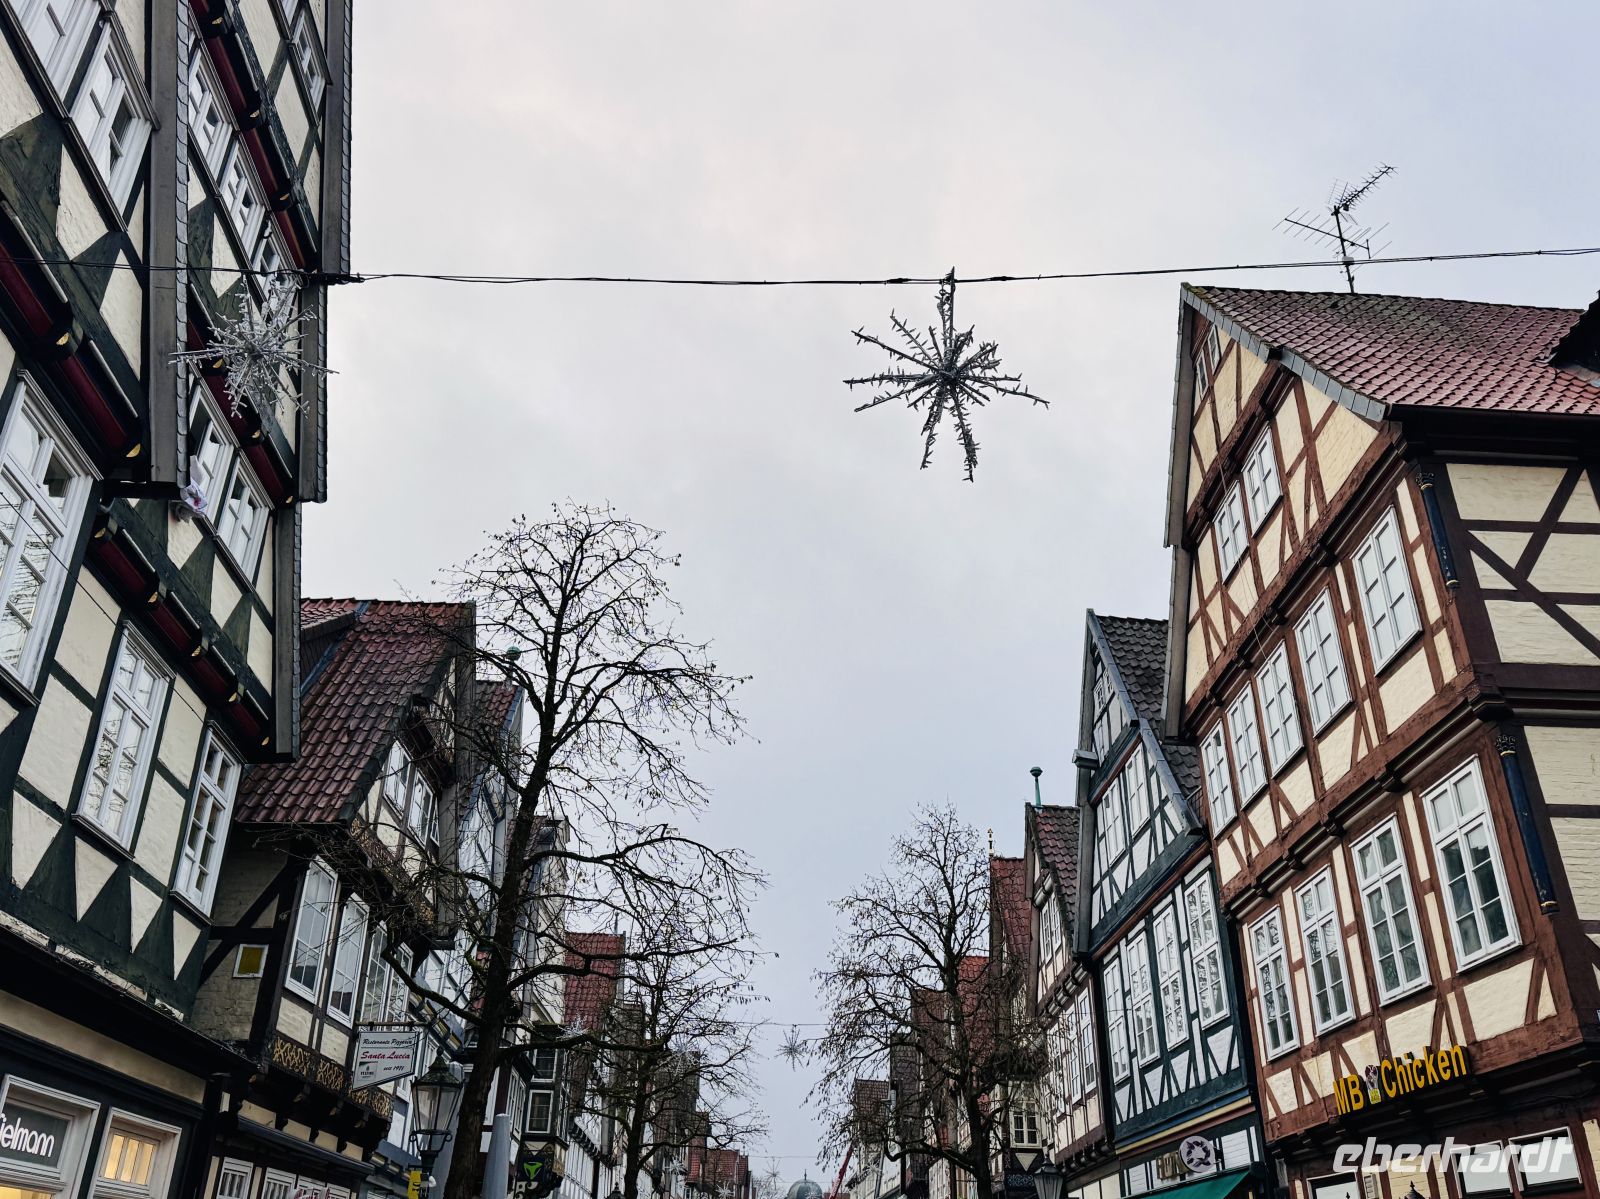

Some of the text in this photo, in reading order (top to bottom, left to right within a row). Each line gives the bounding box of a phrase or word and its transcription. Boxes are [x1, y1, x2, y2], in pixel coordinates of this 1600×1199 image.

[361, 1051, 410, 1060] Santa Lucia
[1333, 1045, 1467, 1115] MB Chicken
[0, 1112, 55, 1157] ielmann
